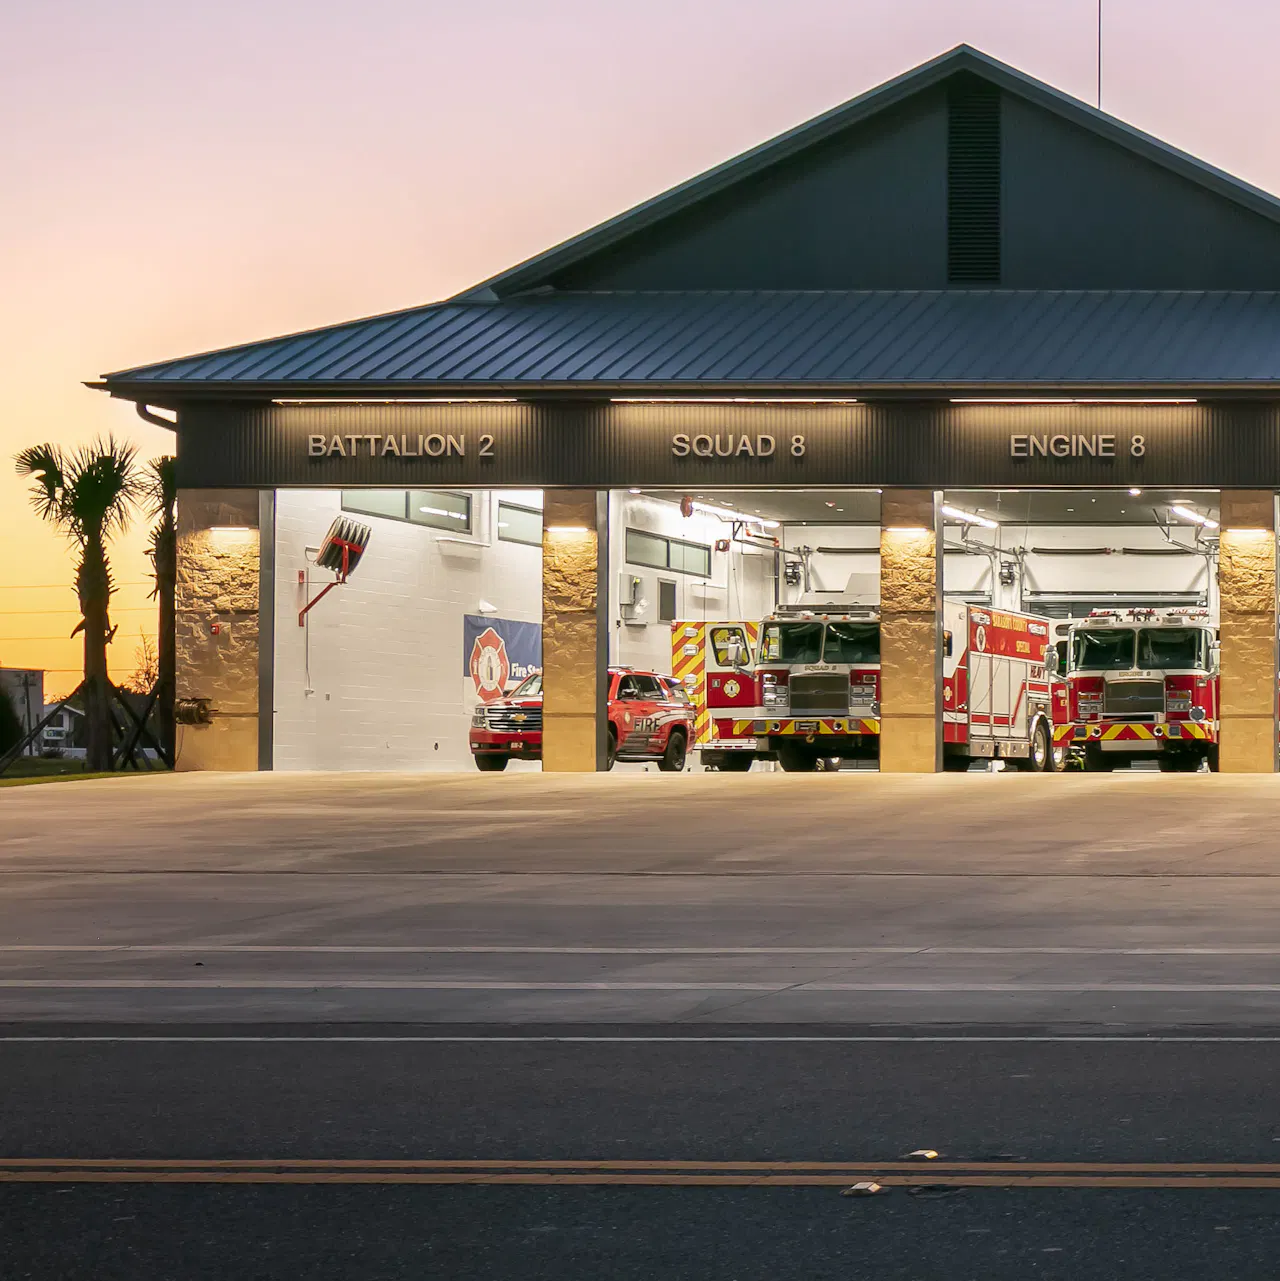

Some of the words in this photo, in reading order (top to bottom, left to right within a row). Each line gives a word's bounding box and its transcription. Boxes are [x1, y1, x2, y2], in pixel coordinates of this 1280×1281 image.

[308, 433, 465, 457] BATTALION
[479, 434, 495, 456] 2
[671, 433, 776, 458] SQUAD
[790, 434, 806, 457] 8
[1010, 434, 1116, 457] ENGINE
[1130, 434, 1146, 457] 8
[511, 662, 527, 678] Fire
[634, 717, 661, 733] FIRE
